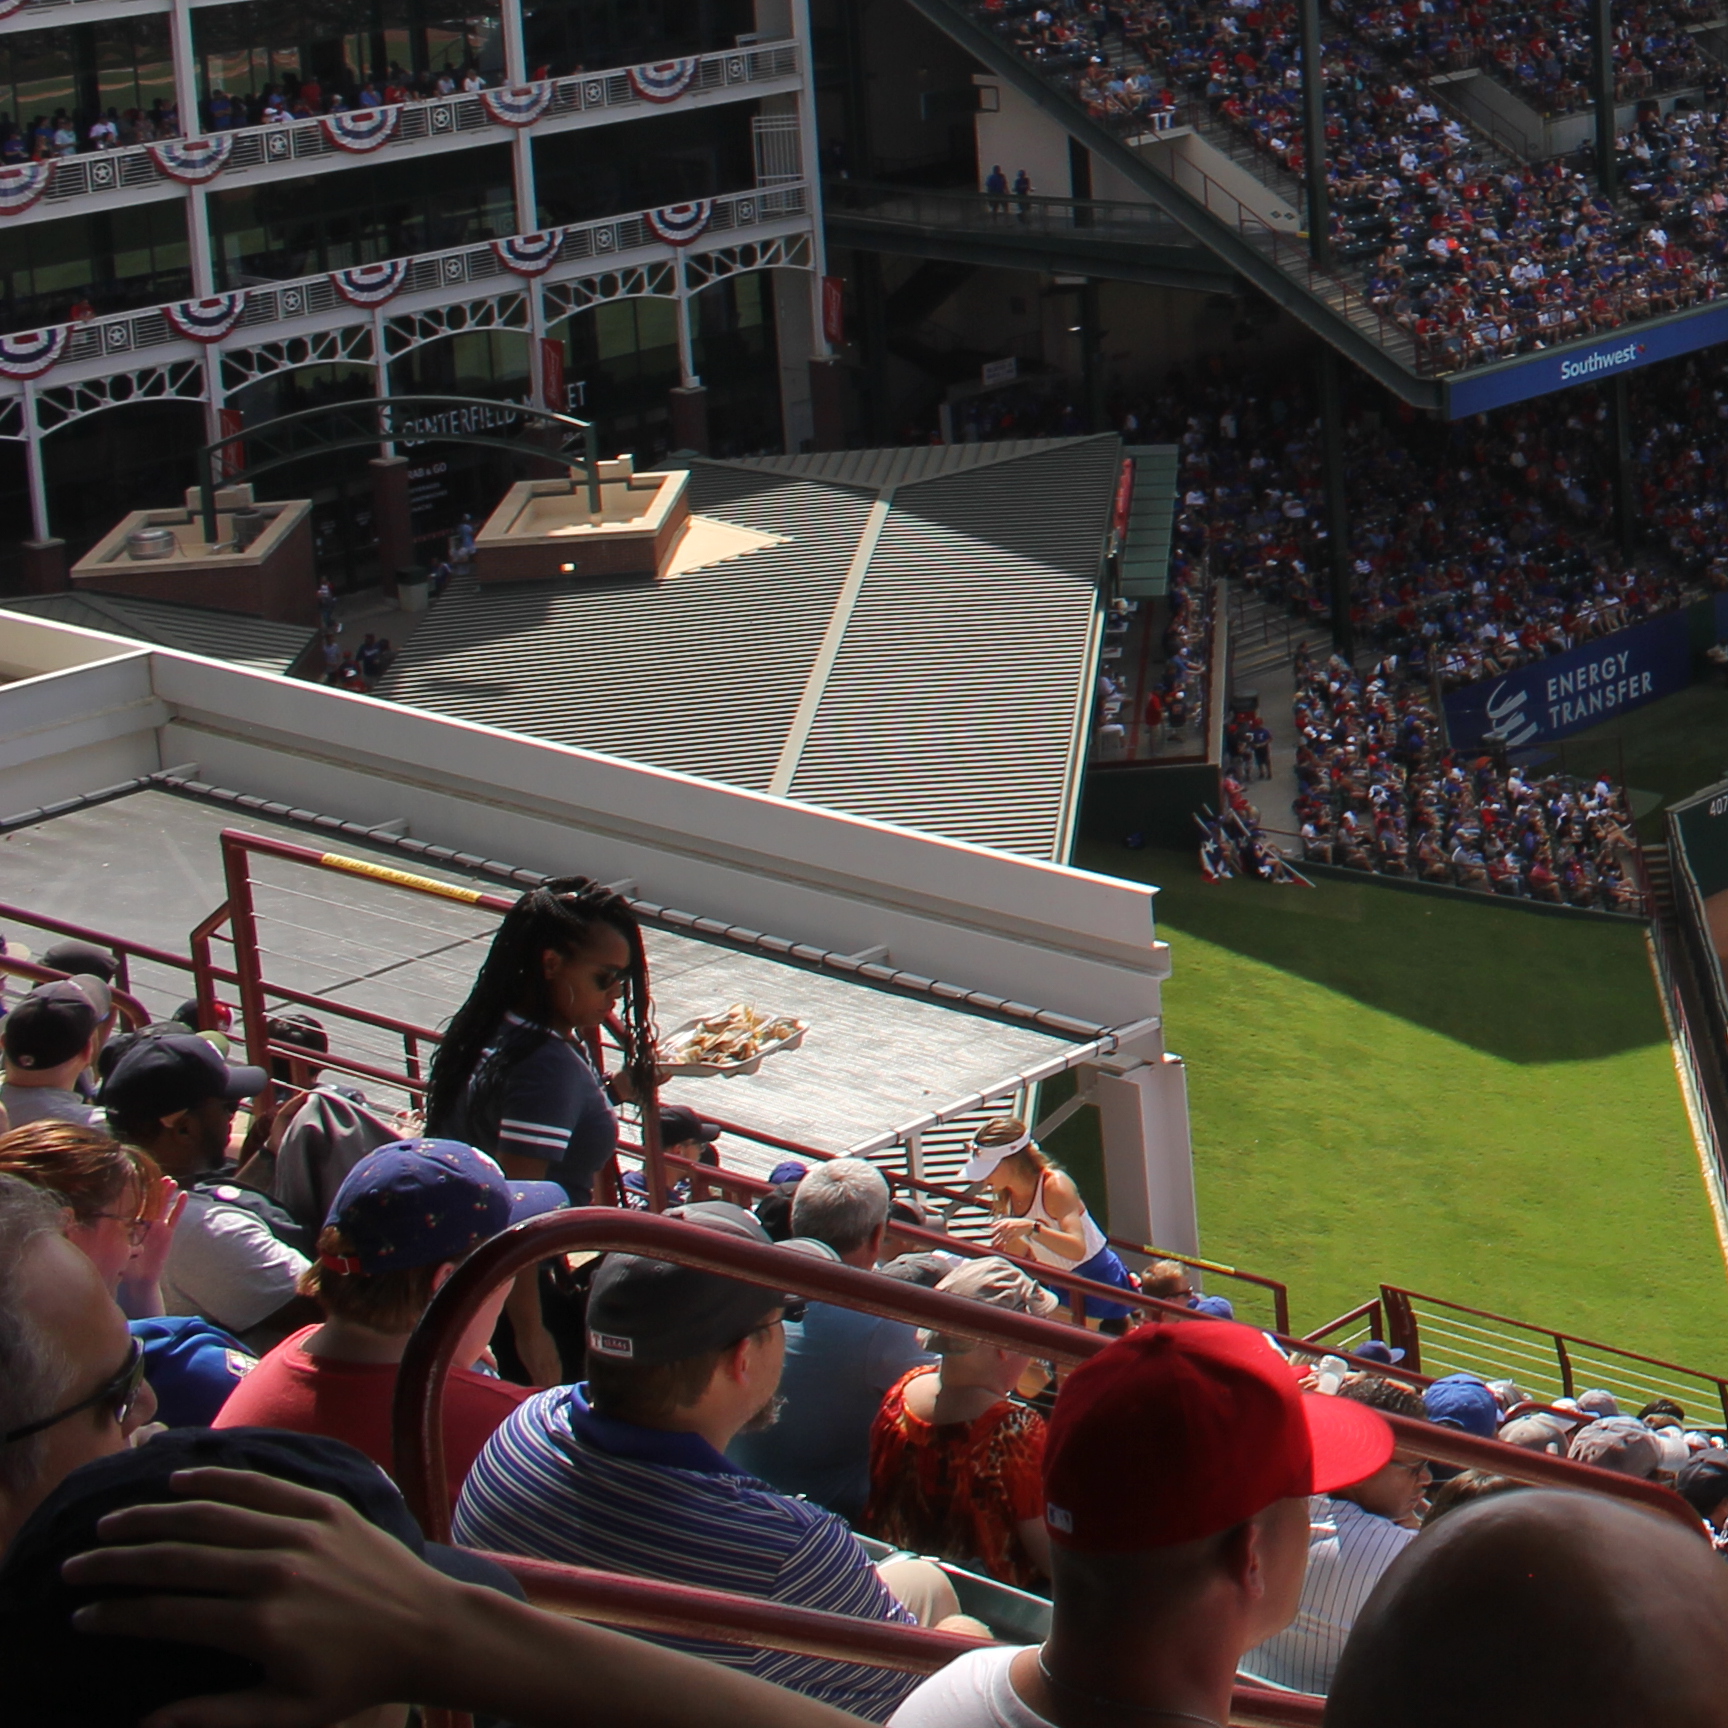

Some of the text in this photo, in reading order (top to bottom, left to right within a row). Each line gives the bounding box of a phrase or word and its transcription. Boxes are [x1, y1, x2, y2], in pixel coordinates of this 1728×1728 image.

[1561, 342, 1635, 380] Southwest
[1546, 650, 1631, 699] ENERGY
[1548, 670, 1653, 733] TRANSFER
[1709, 795, 1728, 816] 407
